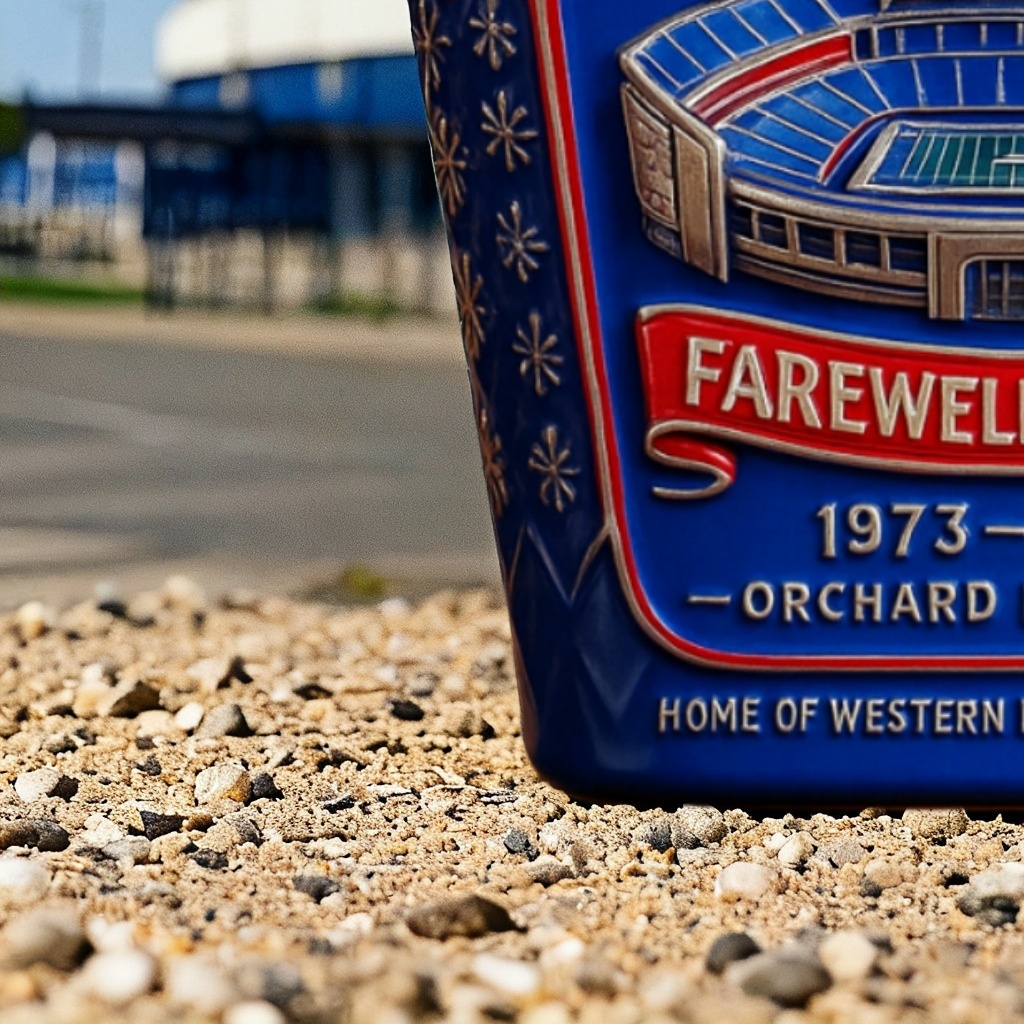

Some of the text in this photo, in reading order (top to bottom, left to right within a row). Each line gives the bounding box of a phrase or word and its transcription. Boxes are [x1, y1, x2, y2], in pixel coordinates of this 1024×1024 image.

[658, 696, 760, 732] HOME
[775, 696, 819, 732] OF
[830, 696, 1005, 734] WESTERN
